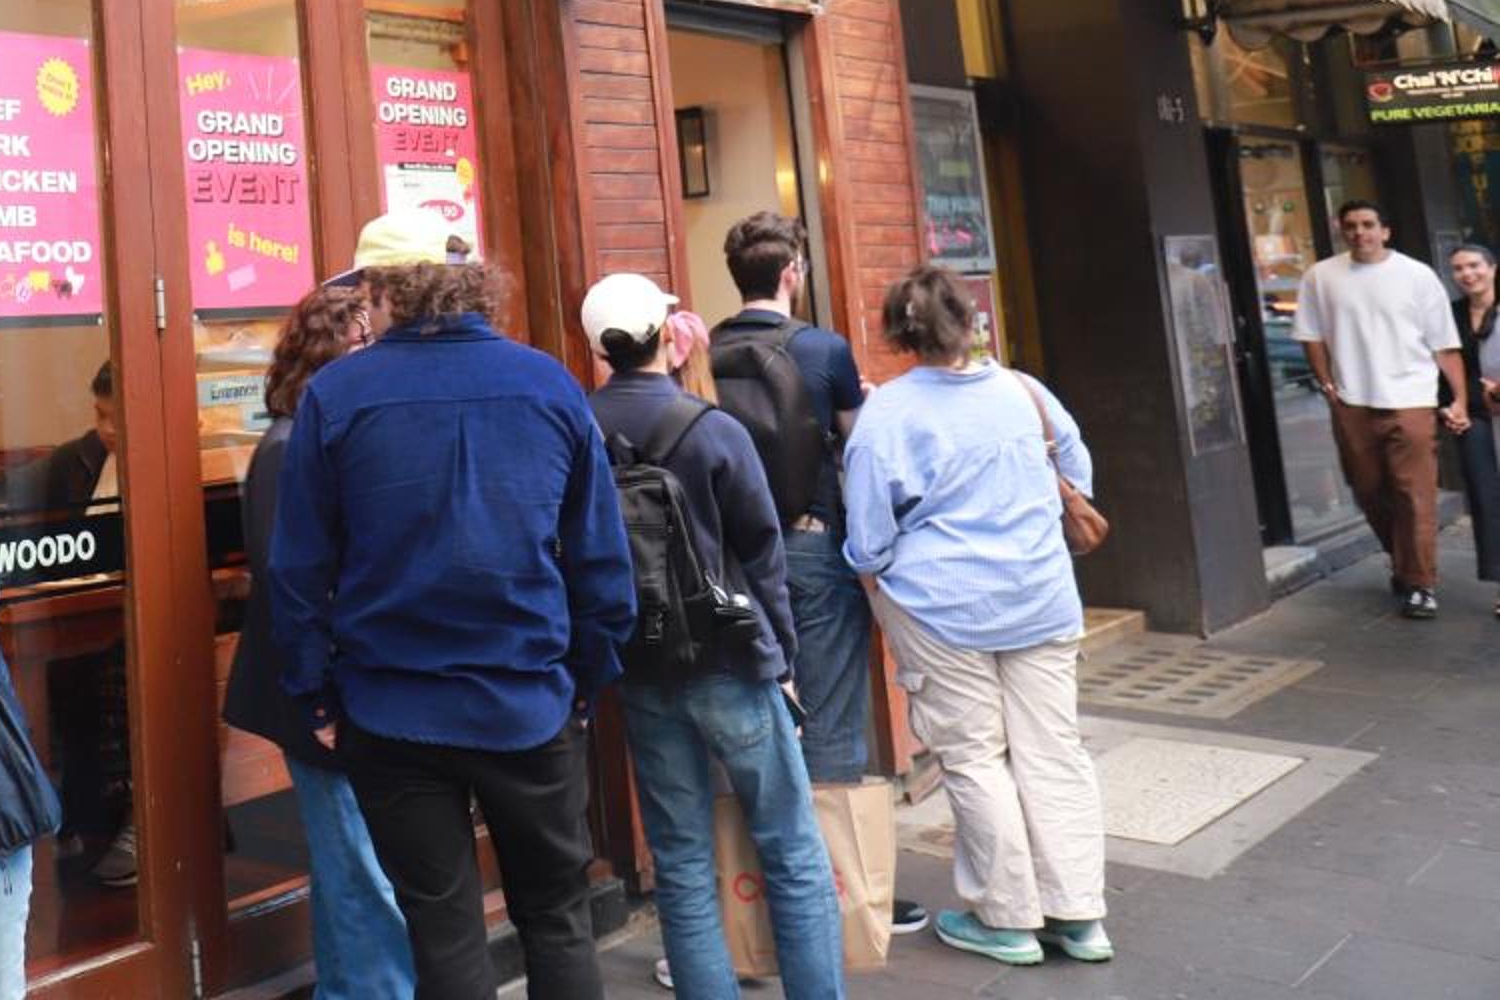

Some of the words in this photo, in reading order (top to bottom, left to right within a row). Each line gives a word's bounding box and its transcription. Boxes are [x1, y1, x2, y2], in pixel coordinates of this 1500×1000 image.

[386, 76, 457, 101] GRAND
[196, 110, 285, 137] GRAND
[379, 101, 468, 128] OPENING
[187, 138, 297, 166] OPENING
[193, 171, 300, 204] EVENT
[228, 222, 246, 248] is
[249, 231, 299, 265] here!
[209, 383, 259, 400] Entrance
